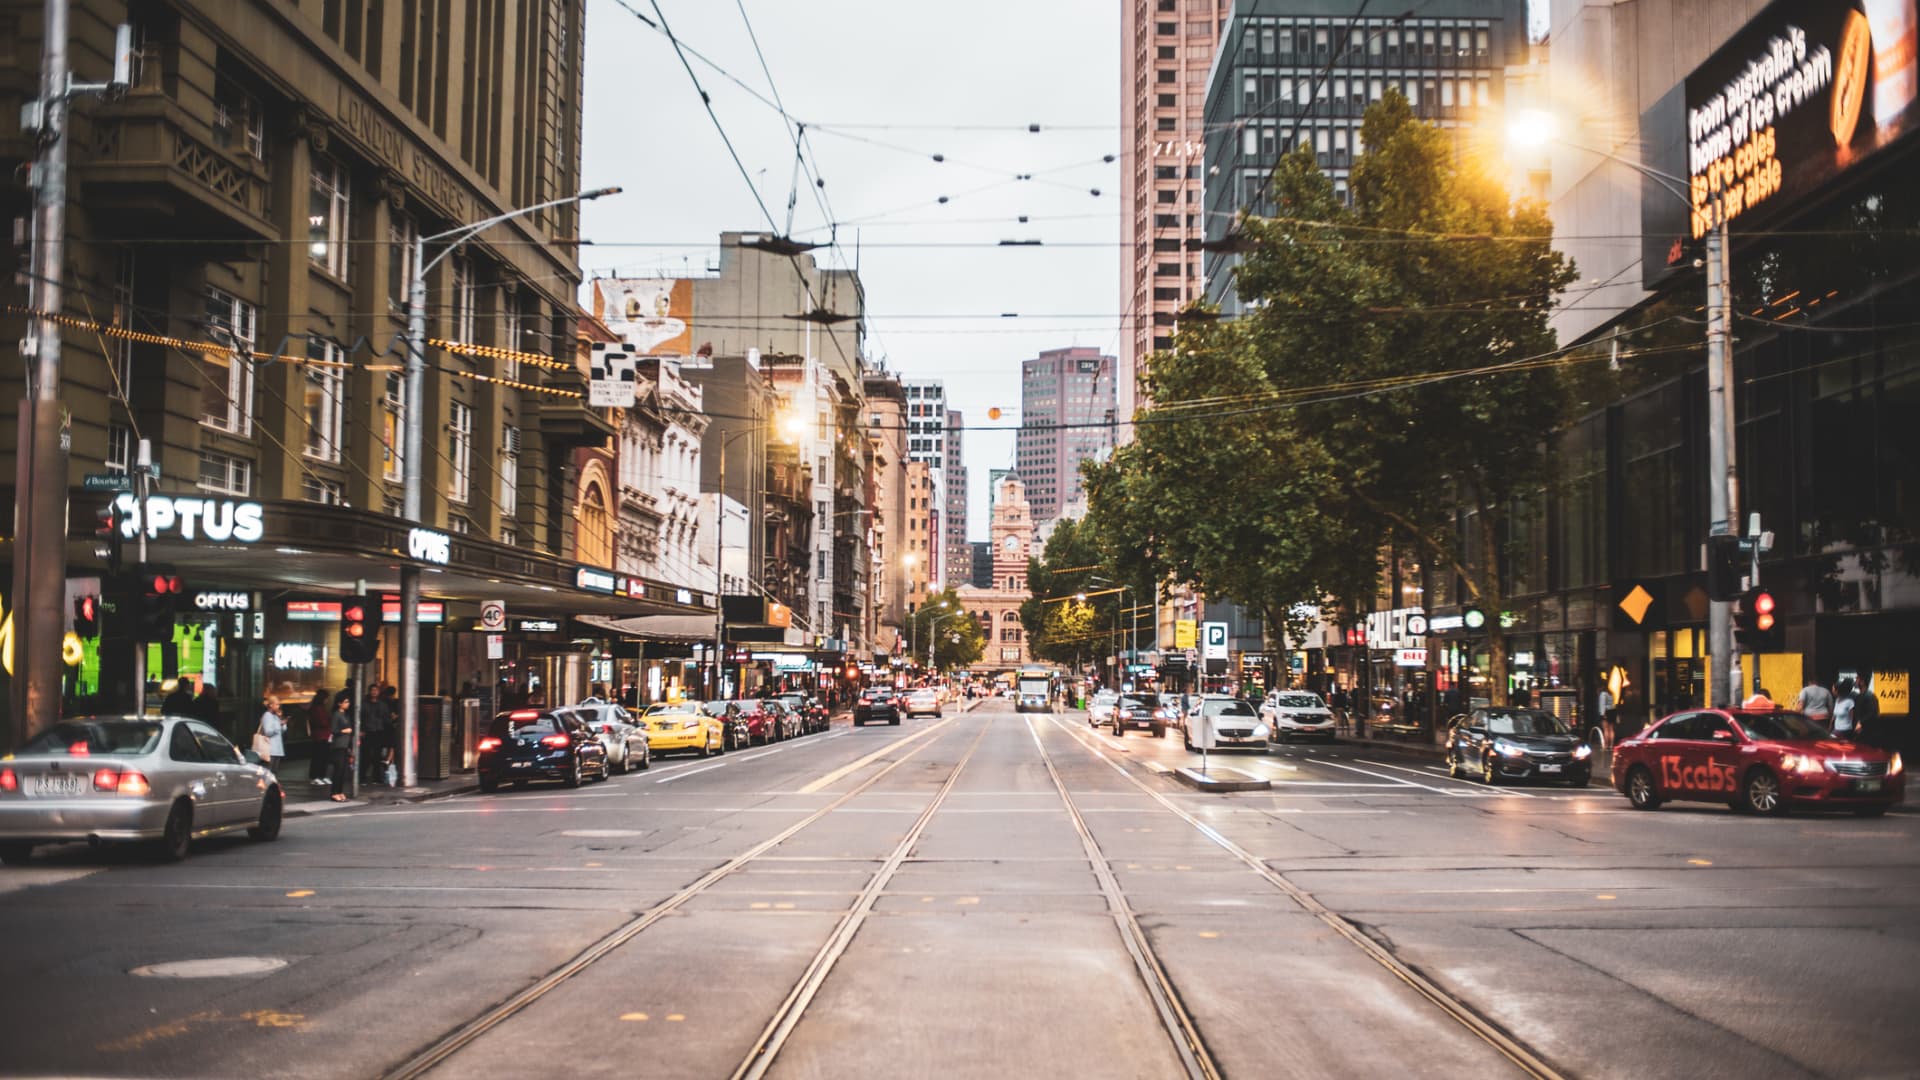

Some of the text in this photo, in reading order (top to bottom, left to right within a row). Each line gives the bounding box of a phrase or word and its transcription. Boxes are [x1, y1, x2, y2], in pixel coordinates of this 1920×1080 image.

[1689, 24, 1806, 142] from australia's
[1689, 44, 1832, 176] home of ice cream
[337, 83, 404, 171] LONDON
[412, 150, 464, 220] STORES
[1691, 174, 1709, 206] to
[1734, 126, 1776, 179] coles
[1744, 157, 1782, 209] aisle
[91, 477, 119, 486] Bourke
[108, 493, 263, 542] OPTUS
[409, 528, 450, 565] OPTUS
[195, 592, 249, 609] OPTUS
[485, 609, 501, 620] 40
[1211, 628, 1223, 643] P
[274, 642, 313, 670] OPTUS
[1661, 755, 1737, 792] 13cabs
